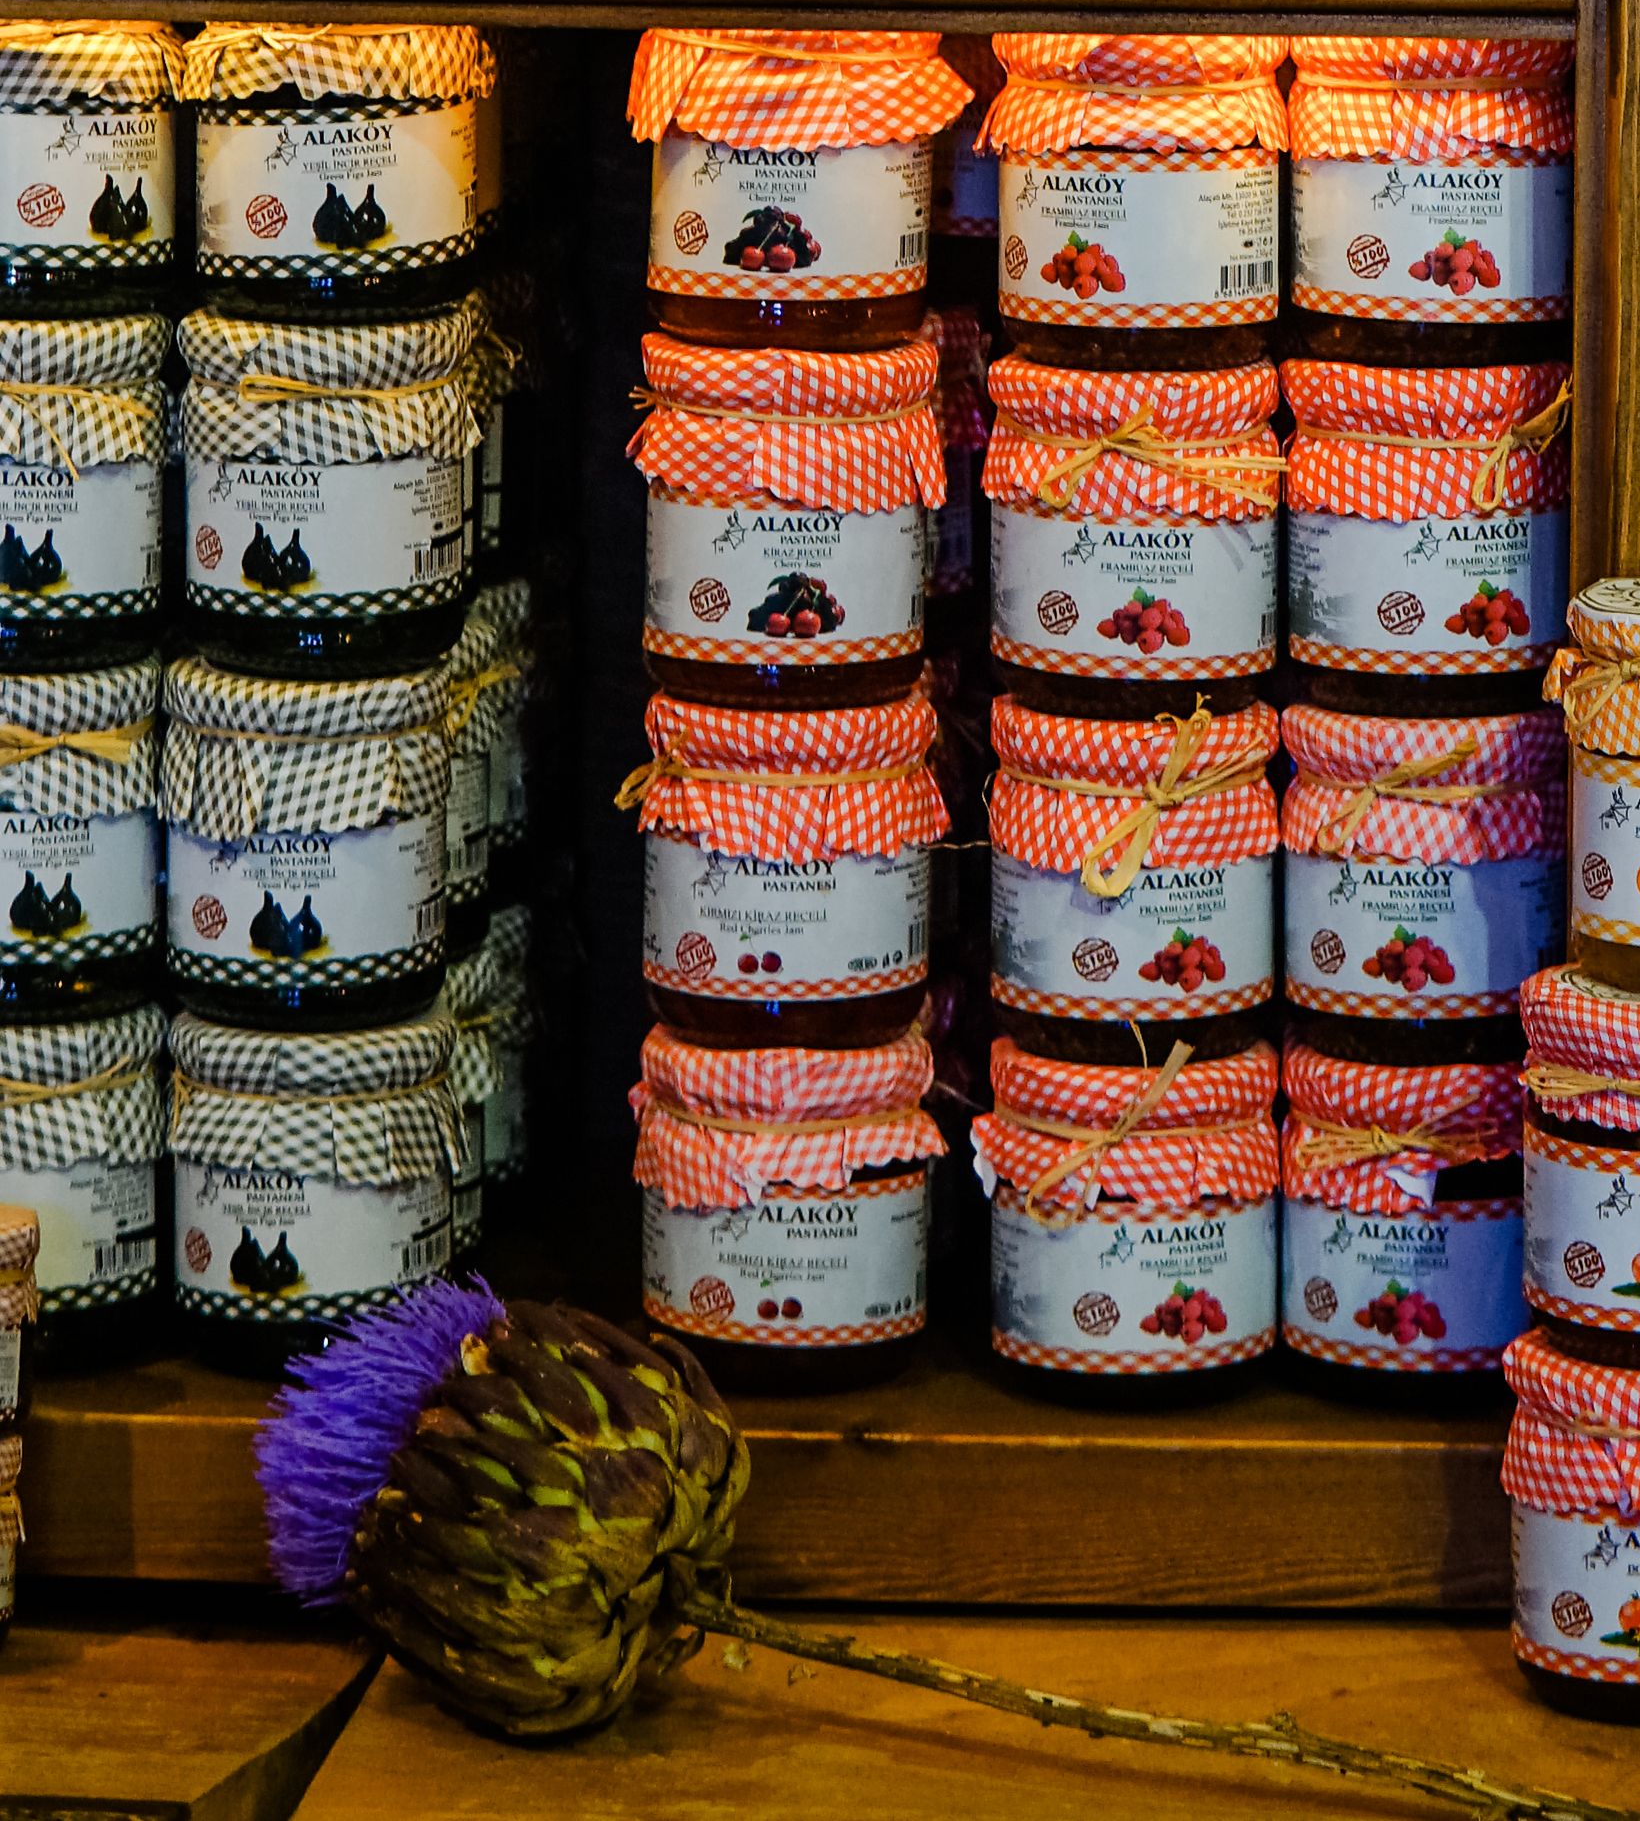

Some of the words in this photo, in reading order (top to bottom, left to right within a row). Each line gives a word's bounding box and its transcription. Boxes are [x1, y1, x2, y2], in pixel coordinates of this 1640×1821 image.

[88, 118, 157, 137] ALAKÖY
[303, 121, 392, 145] ALAKÖY
[112, 138, 155, 149] PASTANESİ
[331, 143, 392, 157] PASTANESİ
[1043, 173, 1126, 194] ALAKÖY
[1413, 170, 1503, 189] ALAKÖY
[1064, 195, 1123, 206] PASTANESİ
[1440, 190, 1500, 202] PASTANESİ
[236, 467, 321, 487] ALAKÖY
[260, 488, 319, 499] PASTANESİ
[752, 512, 842, 533] ALAKÖY
[1445, 521, 1529, 542] ALAKÖY
[780, 534, 840, 545] PASTANESİ
[1102, 528, 1193, 549] ALAKÖY
[1130, 549, 1190, 561] PASTANESİ
[1362, 866, 1453, 888] ALAKÖY
[1389, 888, 1451, 899] PASTANESİ
[757, 1203, 857, 1225] ALAKÖY
[786, 1226, 857, 1239] PASTANESİ
[1140, 1221, 1225, 1243] ALAKÖY
